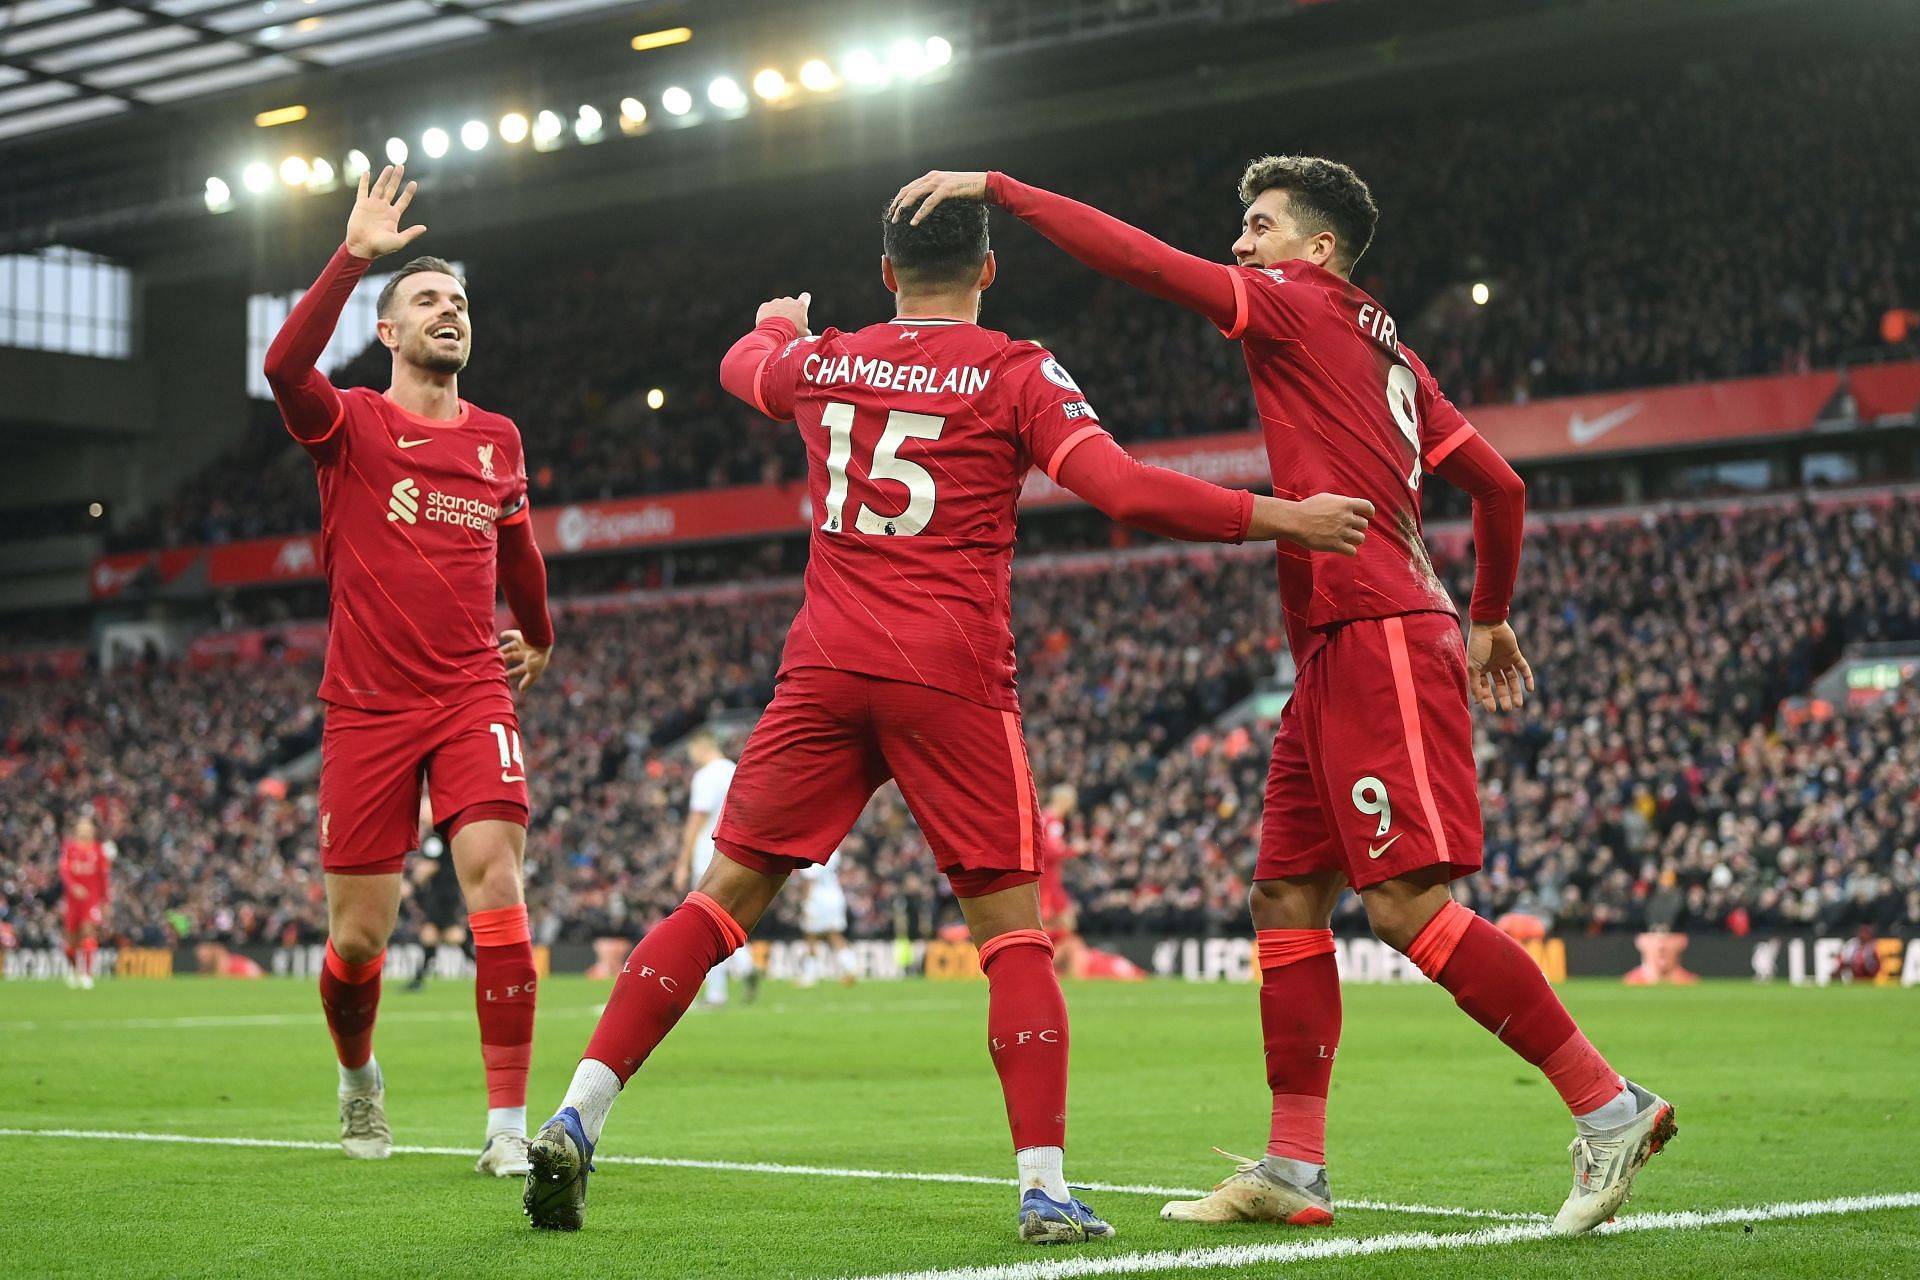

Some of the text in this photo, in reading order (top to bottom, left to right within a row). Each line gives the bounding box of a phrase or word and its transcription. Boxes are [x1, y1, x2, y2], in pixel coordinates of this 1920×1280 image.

[803, 353, 990, 394] CHAMBERLAIN
[820, 402, 945, 536] 15
[1352, 776, 1391, 837] 9
[992, 1029, 1058, 1051] LFC
